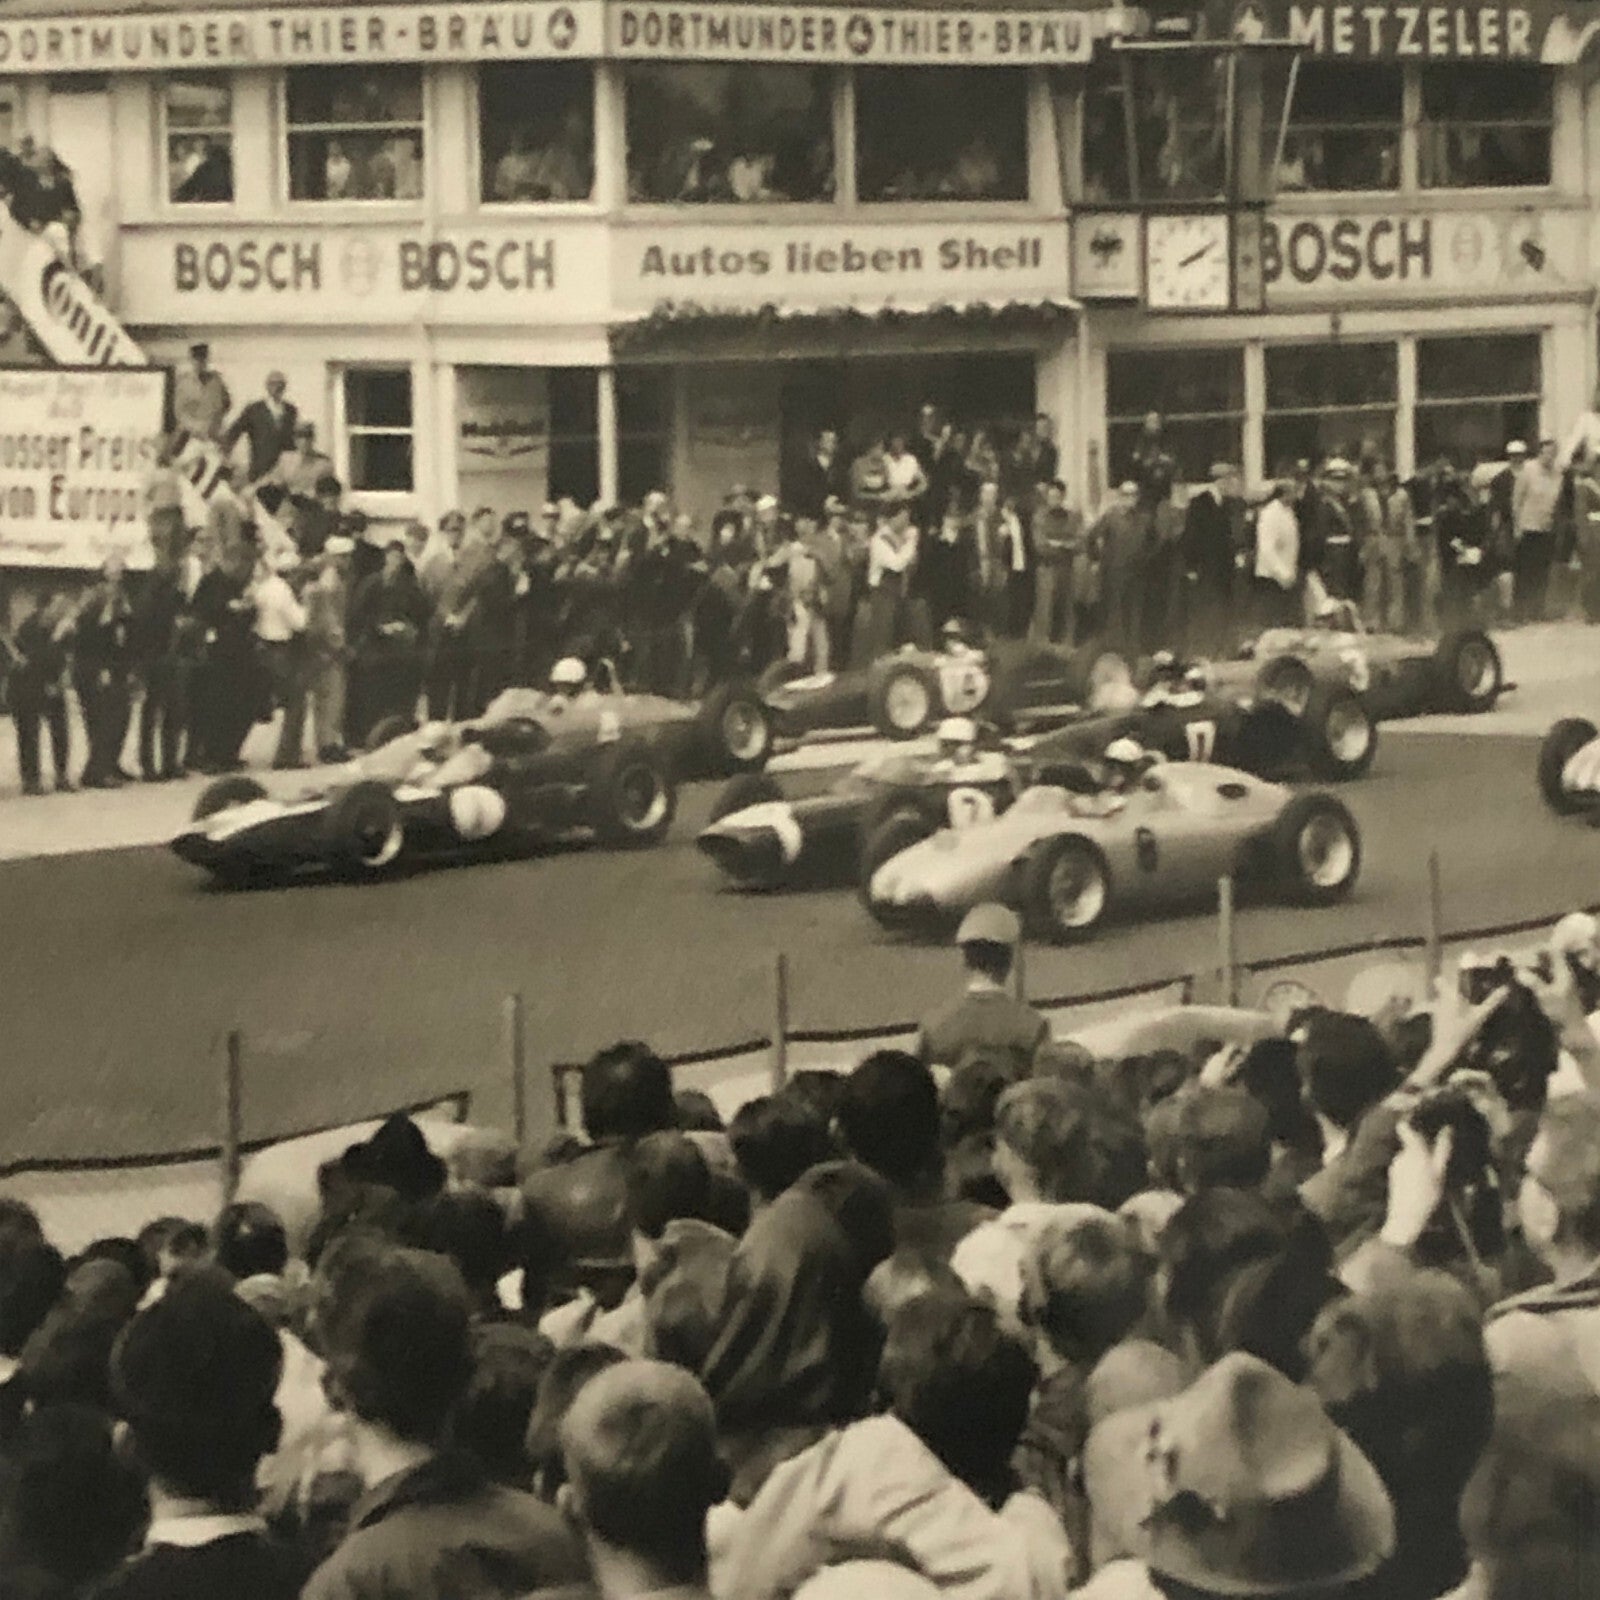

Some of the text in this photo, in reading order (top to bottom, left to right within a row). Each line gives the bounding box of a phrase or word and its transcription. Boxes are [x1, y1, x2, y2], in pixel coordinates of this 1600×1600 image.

[620, 13, 836, 51] DORTMUNDER
[1289, 5, 1532, 55] METZELER
[174, 240, 322, 292] BOSCH
[400, 239, 555, 291] BOSCH
[640, 237, 1042, 277] Autos lieben Shell
[1264, 217, 1433, 283] BOSCH
